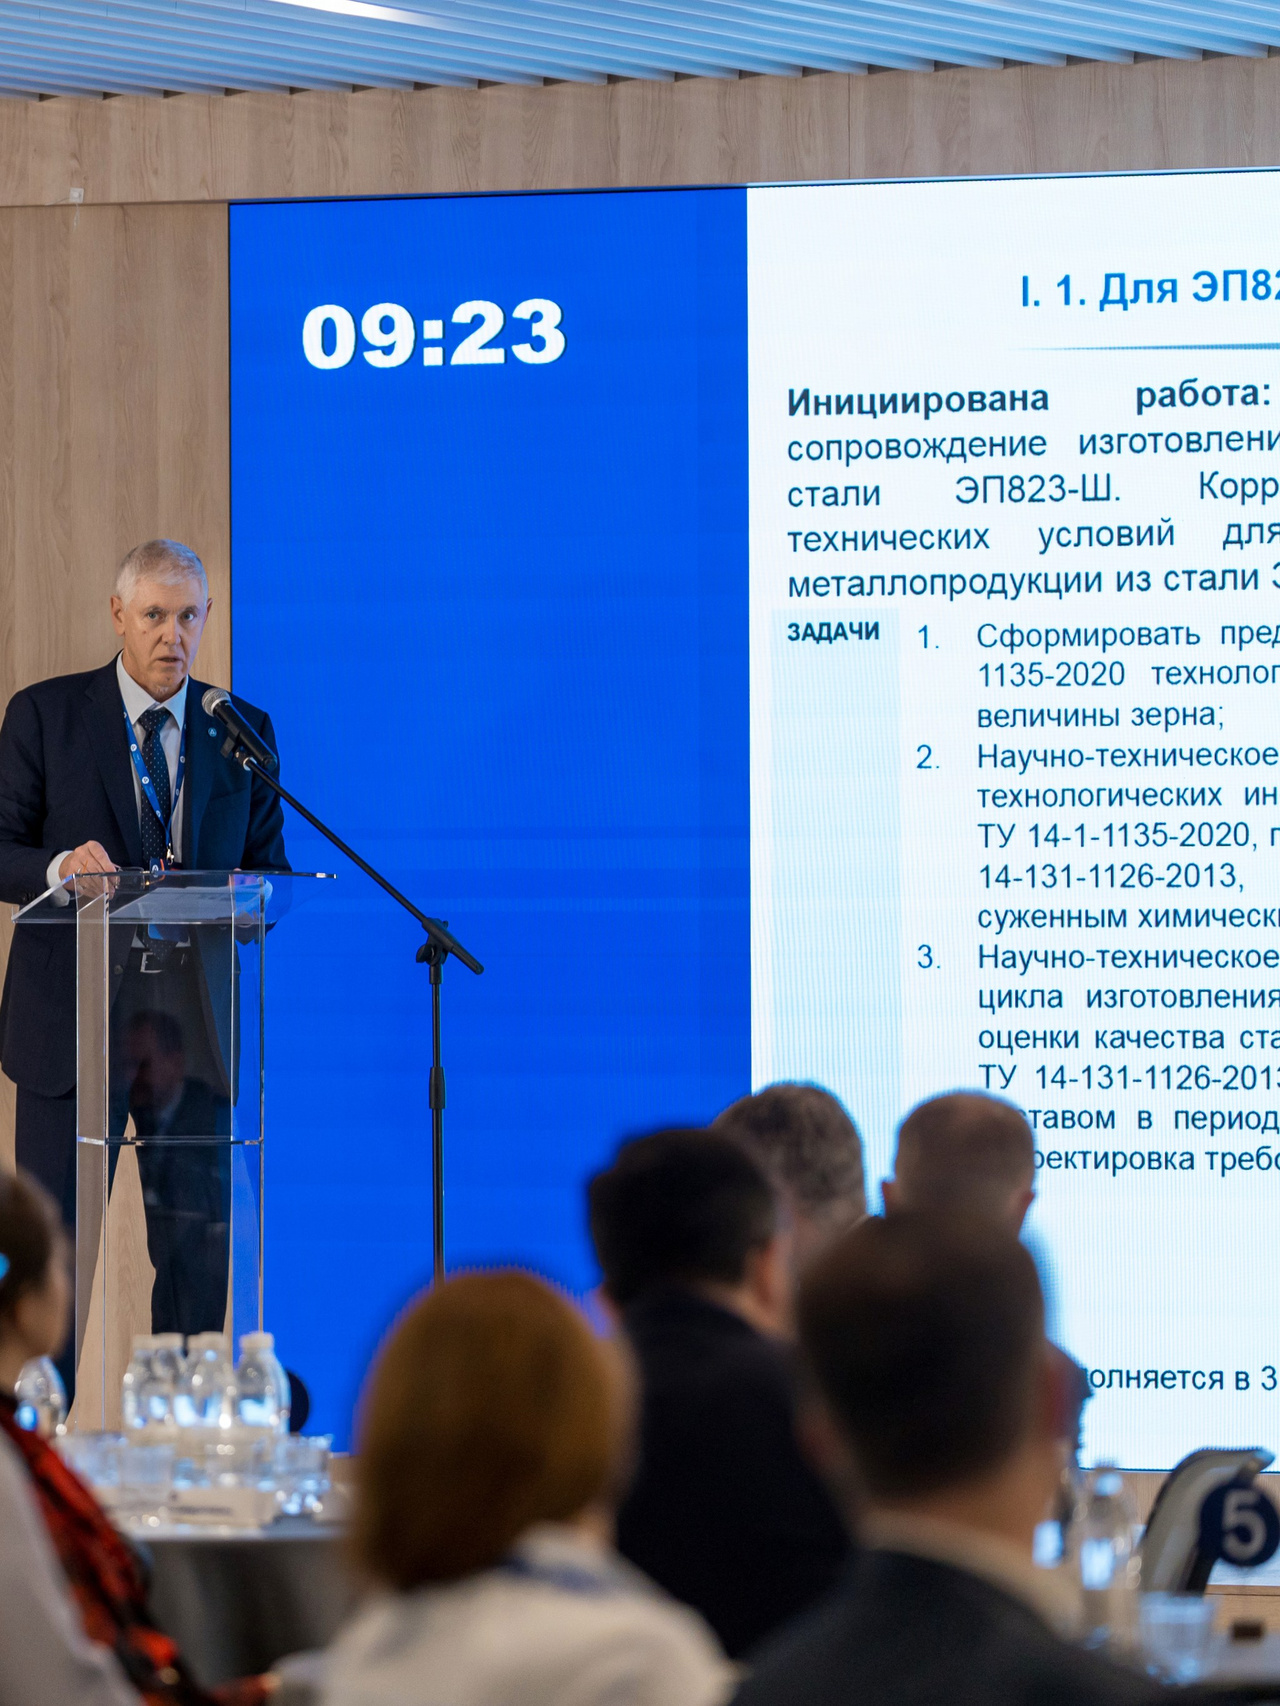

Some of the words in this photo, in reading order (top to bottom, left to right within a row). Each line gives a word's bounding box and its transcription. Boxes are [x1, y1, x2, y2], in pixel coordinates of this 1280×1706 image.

[1056, 273, 1086, 306] 1.
[1098, 272, 1178, 313] Для
[301, 297, 567, 371] 09:23
[787, 387, 1050, 421] Инициирована
[1136, 377, 1271, 416] работа:
[787, 434, 1048, 468] сопровождение
[787, 483, 881, 508] стали
[955, 472, 1121, 505] ЭП823-Ш.
[1199, 470, 1280, 506] Корр
[786, 526, 991, 553] технических
[1038, 516, 1175, 556] условий
[1222, 521, 1280, 551] для
[788, 569, 1103, 602] металлопродукции
[1116, 570, 1152, 593] из
[1163, 568, 1259, 592] стали
[787, 620, 880, 645] ЗАДАЧИ
[918, 624, 940, 650] 1.
[977, 621, 1201, 655] Сформировать
[979, 660, 1126, 688] 1135-2020
[977, 706, 1120, 729] величины
[1131, 704, 1224, 734] зерна;
[916, 743, 940, 770] 2.
[978, 743, 1280, 776] Научно-техническое
[976, 786, 1223, 809] технологических
[1244, 786, 1278, 806] ин
[976, 822, 1016, 849] ТУ
[1028, 821, 1257, 852] 14-1-1135-2020,
[979, 861, 1244, 893] 14-131-1126-2013,
[977, 907, 1128, 936] суженным
[1137, 907, 1280, 929] химическ
[917, 943, 941, 970] 3.
[978, 943, 1280, 977] Научно-техническое
[978, 988, 1064, 1016] цикла
[1086, 988, 1280, 1010] изготовления
[978, 1029, 1080, 1057] оценки
[1095, 1029, 1225, 1051] качества
[978, 1063, 1018, 1091] ТУ
[1035, 1063, 1280, 1091] 14-131-1126-201
[1019, 1109, 1116, 1130] тавом
[1137, 1109, 1154, 1130] в
[1174, 1109, 1280, 1137] период
[1033, 1149, 1195, 1178] ректировка
[1087, 1367, 1225, 1392] олняется
[1234, 1370, 1251, 1392] в
[1222, 1488, 1267, 1560] 5
